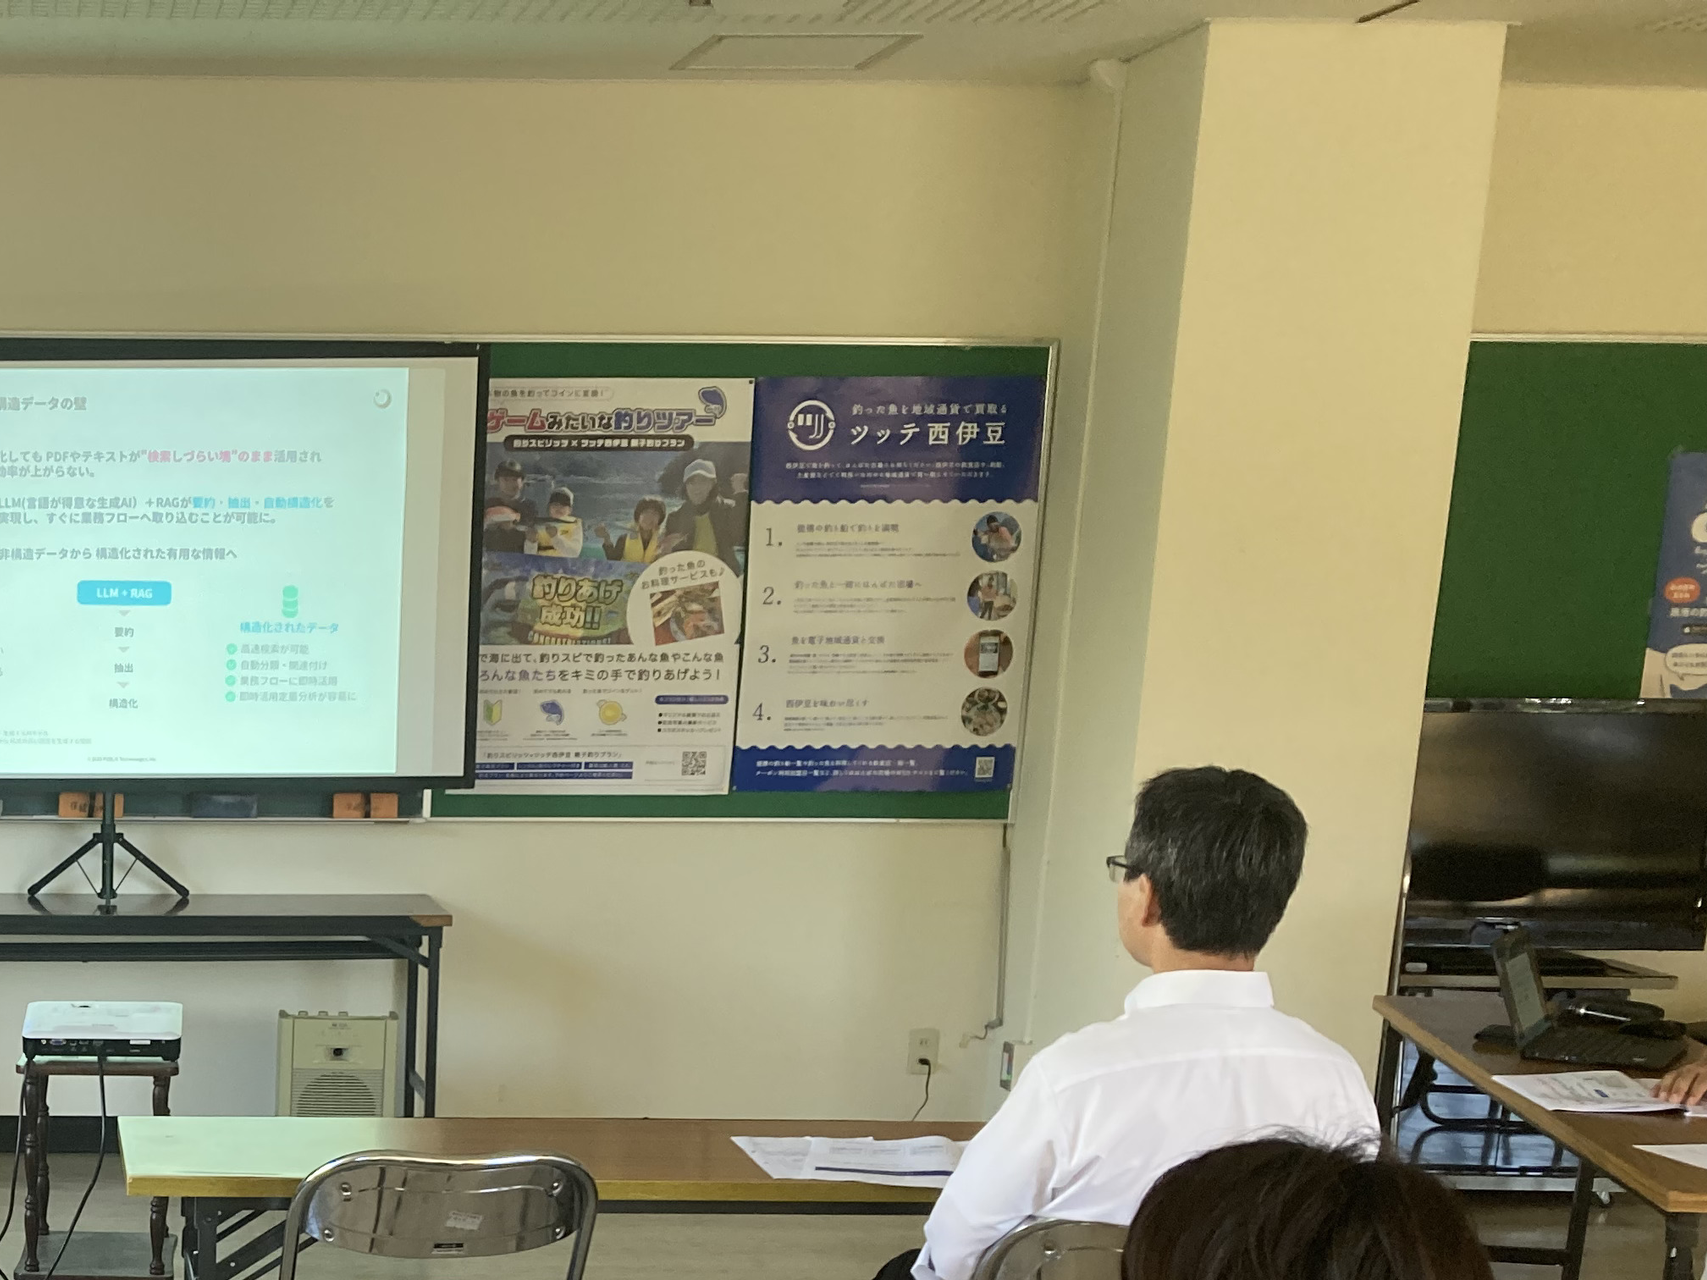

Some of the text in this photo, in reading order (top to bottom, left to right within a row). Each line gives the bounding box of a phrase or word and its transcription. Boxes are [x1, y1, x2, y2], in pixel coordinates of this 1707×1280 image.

[850, 421, 1007, 446] ツッテ西伊豆
[96, 588, 119, 598] LLM
[130, 588, 153, 599] RAG
[531, 573, 625, 605] 釣りあげ
[114, 627, 135, 638] 要約
[239, 620, 340, 634] 構造化されたデータ
[757, 644, 777, 664] 3.
[114, 663, 134, 674] 抽出
[108, 698, 139, 709] 構造化
[752, 703, 772, 721] 4.
